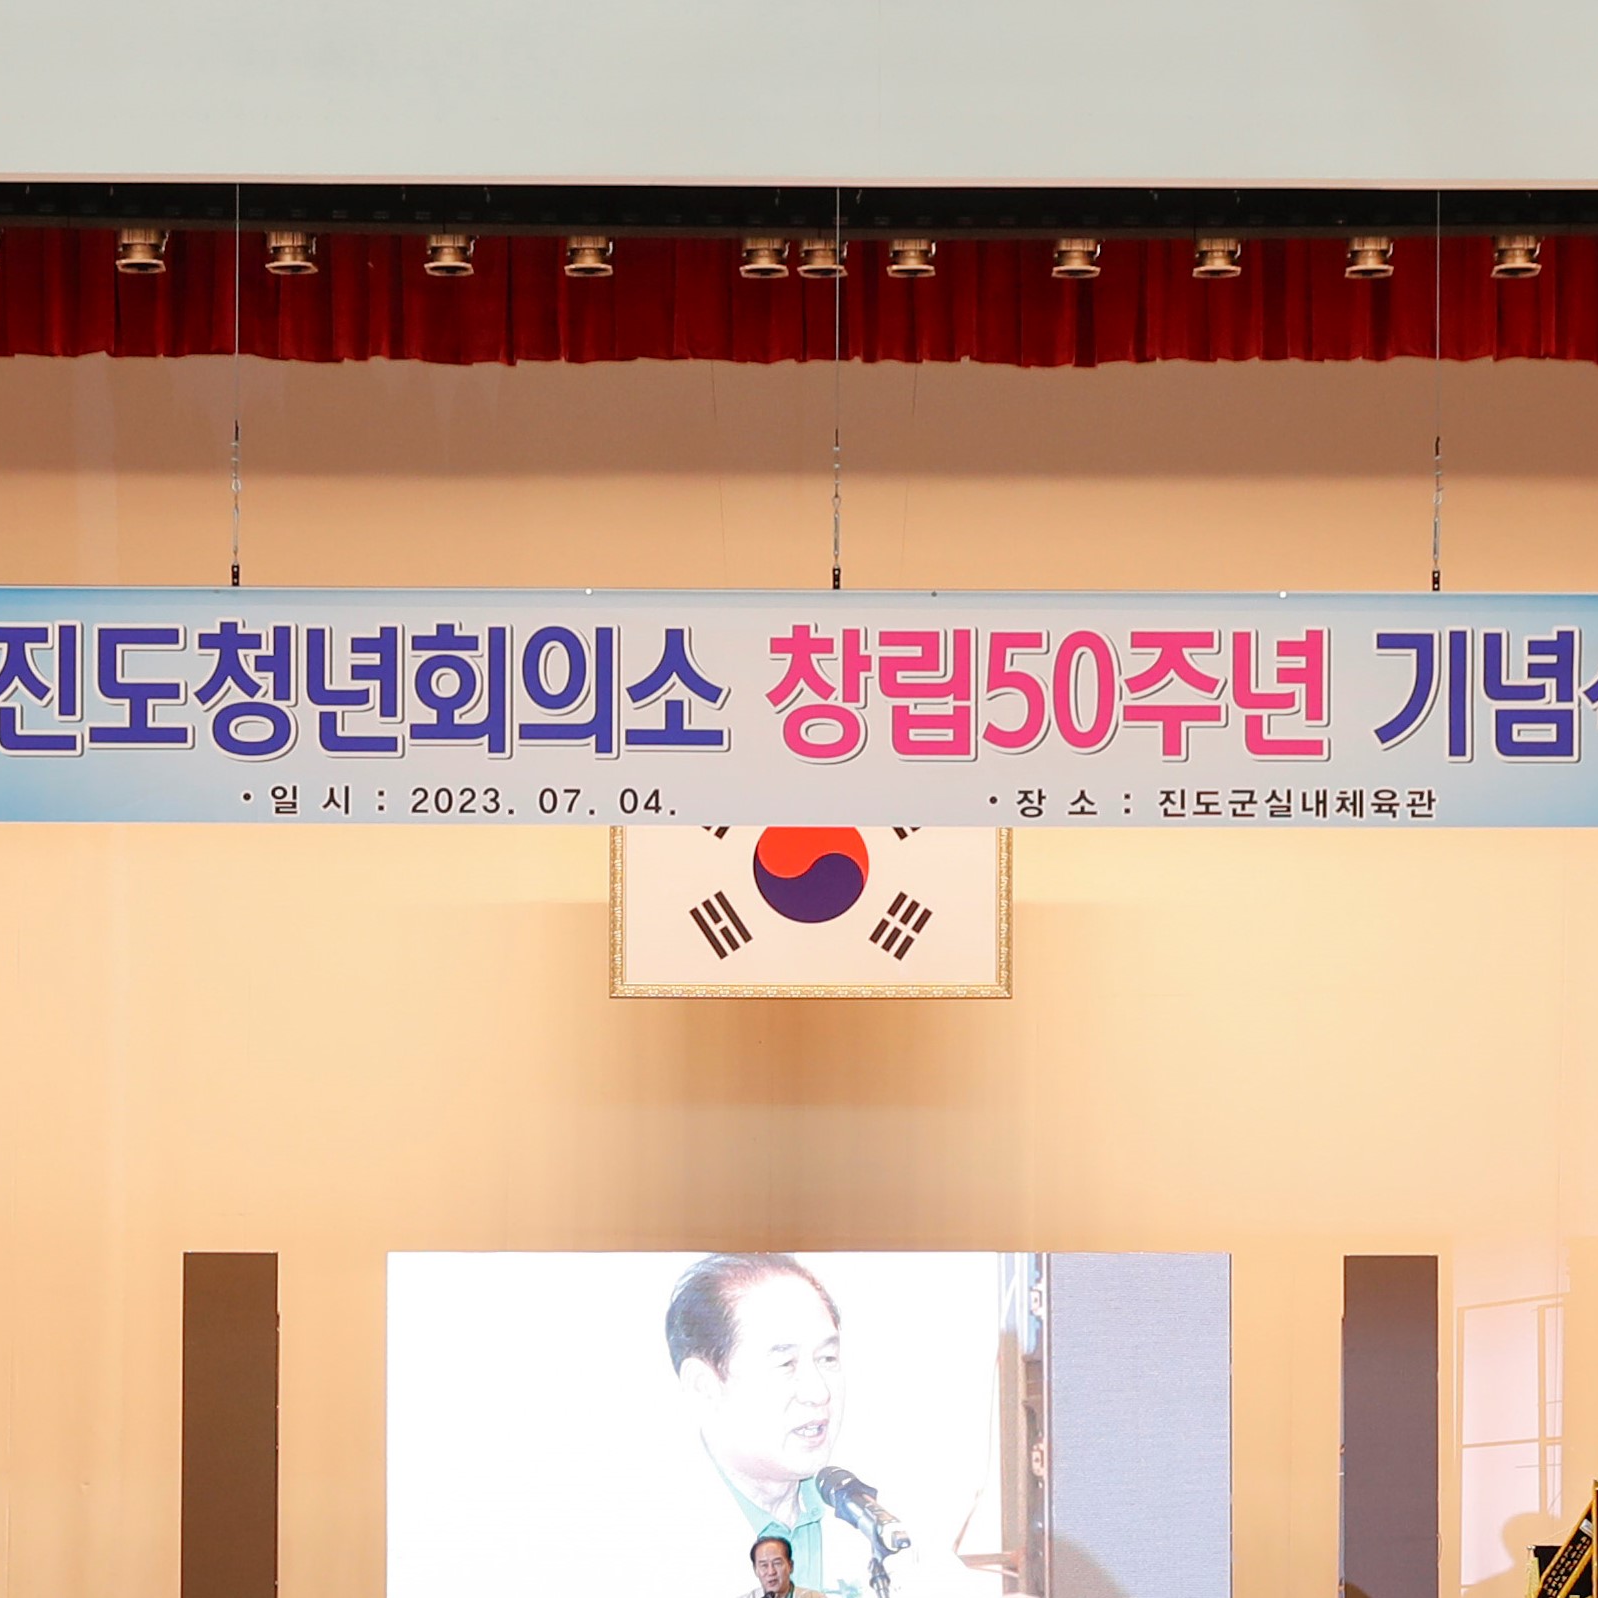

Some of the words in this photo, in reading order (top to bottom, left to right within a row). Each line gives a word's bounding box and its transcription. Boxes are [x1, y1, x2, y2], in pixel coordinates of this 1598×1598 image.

[765, 624, 1328, 759] 창립50주년
[411, 787, 514, 816] 2023.
[539, 788, 596, 816] 07.
[619, 788, 677, 816] 04.
[1158, 788, 1436, 818] 진도군실내체육관
